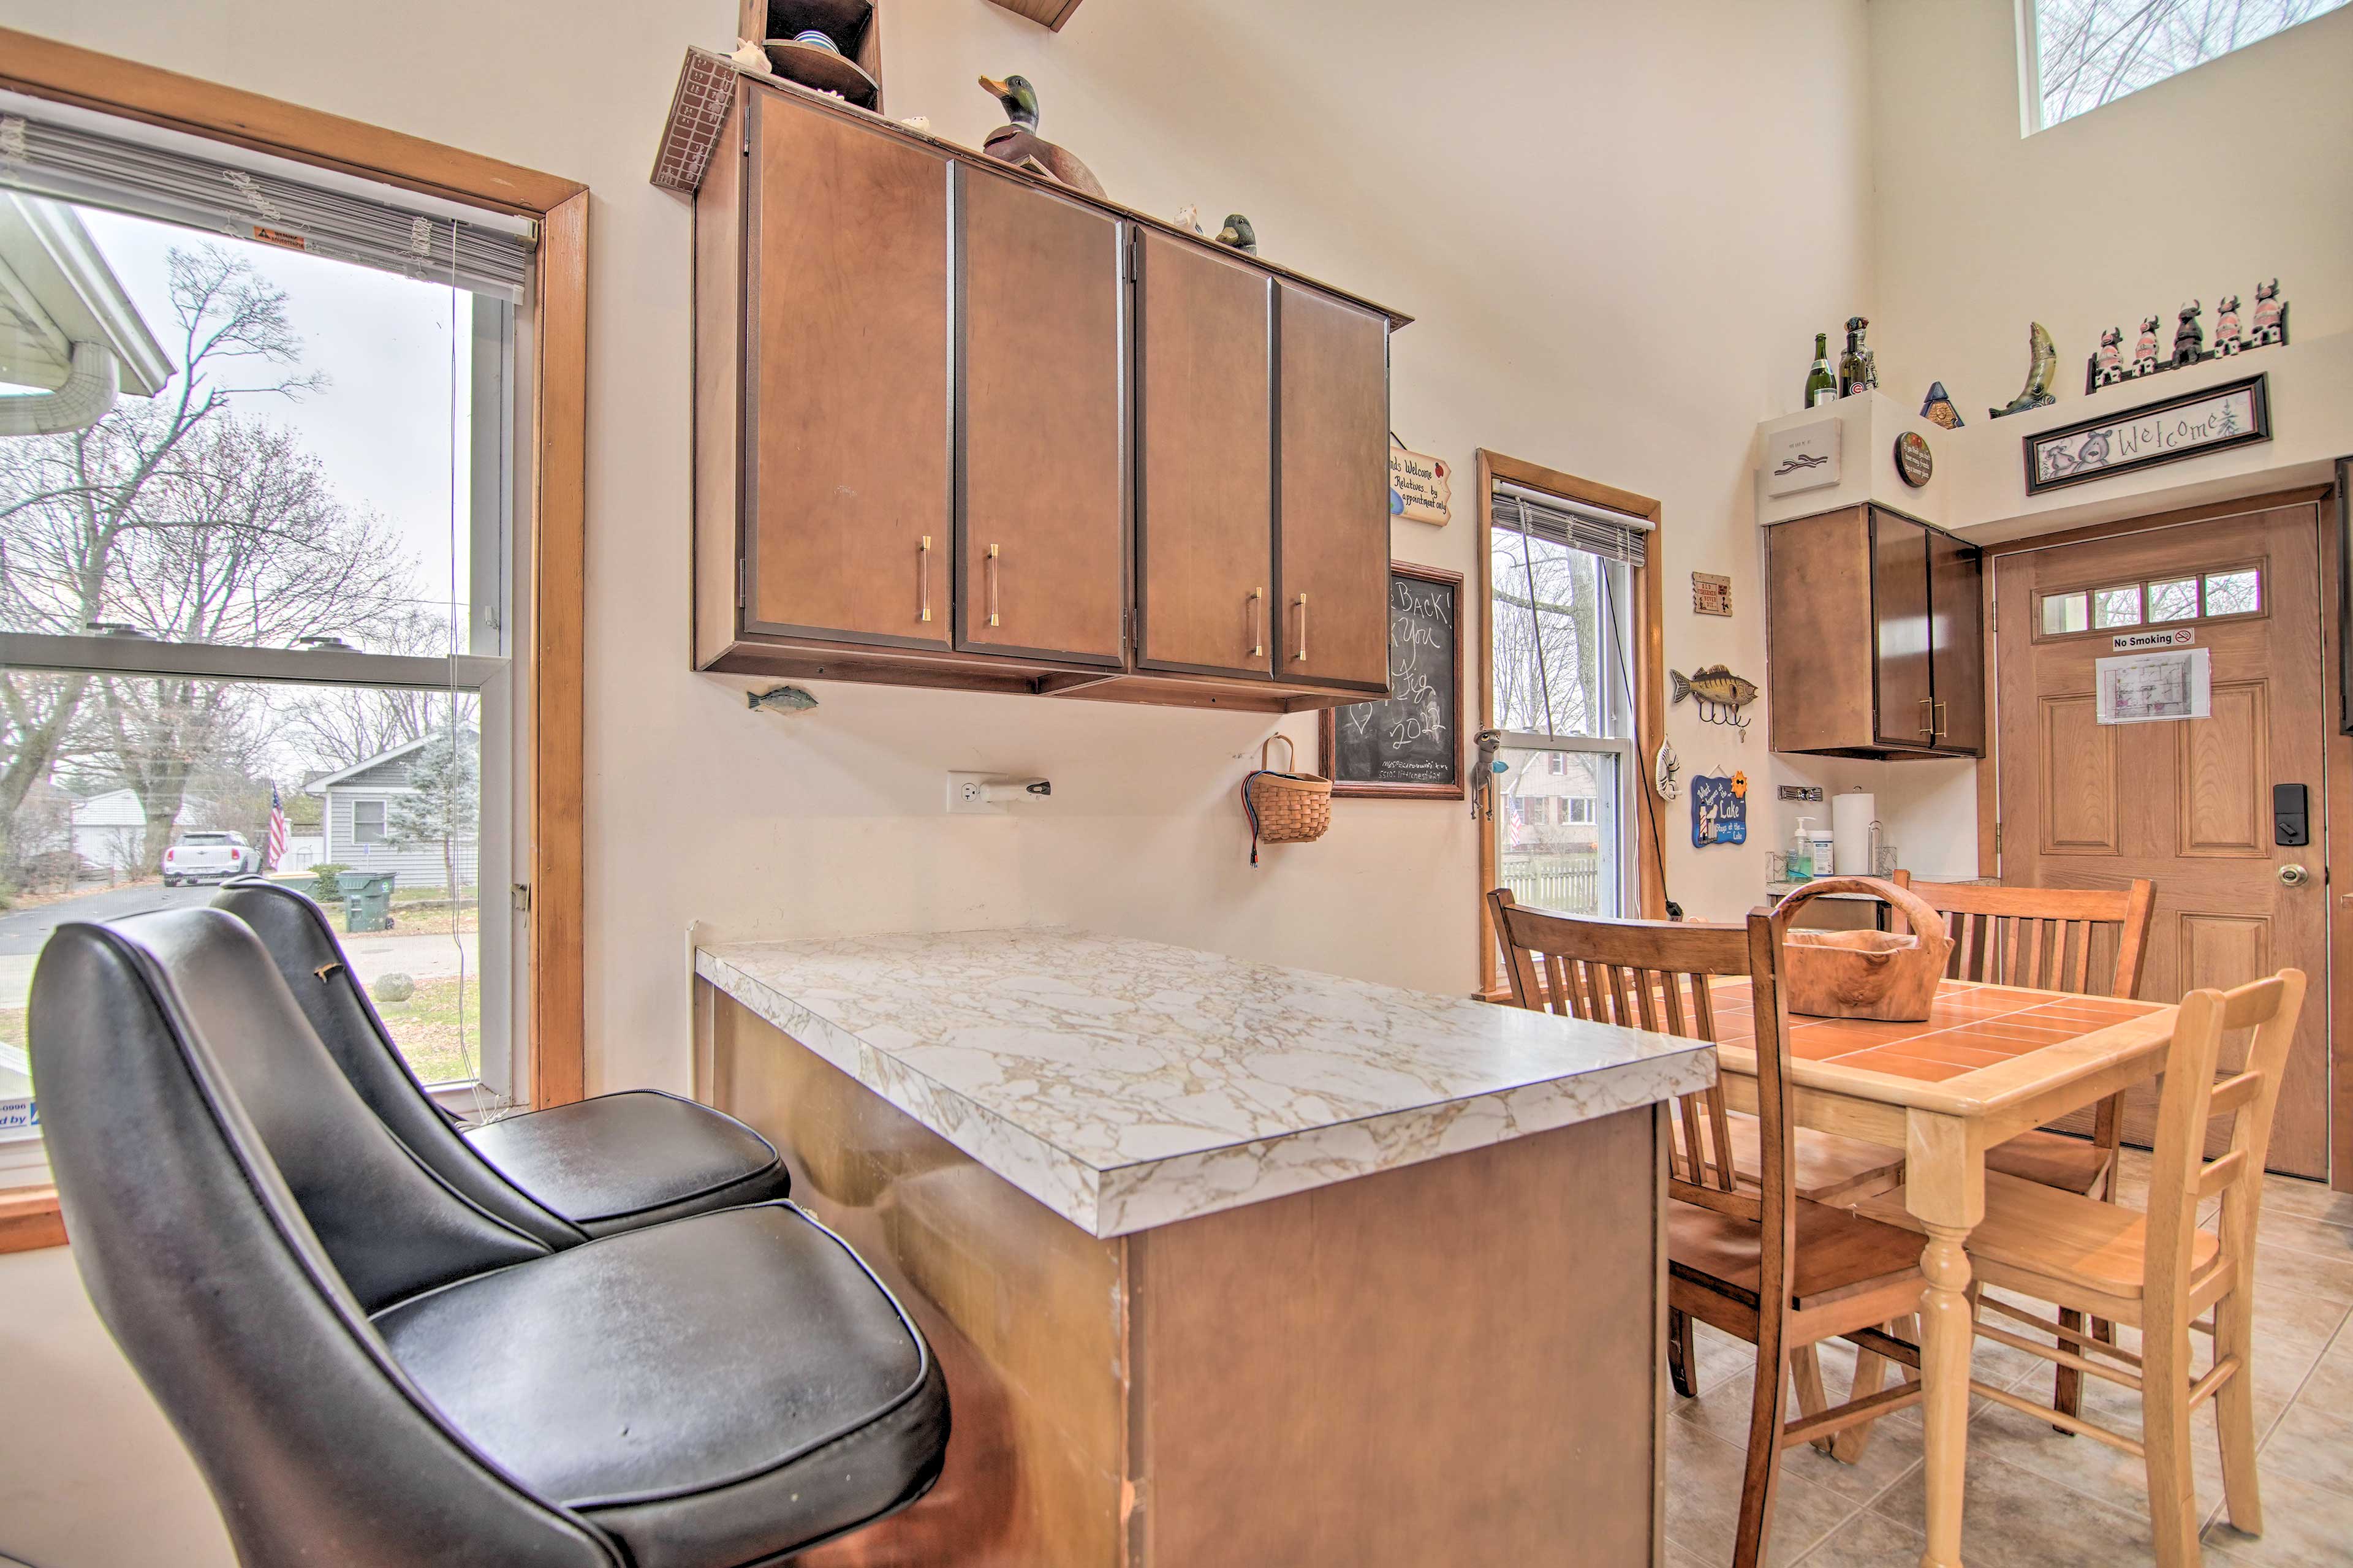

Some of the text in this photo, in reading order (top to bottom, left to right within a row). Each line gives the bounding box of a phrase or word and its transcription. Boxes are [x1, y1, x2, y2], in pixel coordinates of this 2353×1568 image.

[2118, 413, 2218, 456] Welcome
[1404, 459, 1433, 480] Welcome
[1431, 485, 1438, 499] by
[1403, 493, 1447, 515] appointment only
[2114, 634, 2172, 648] No Smoking
[1697, 782, 1711, 800] What
[1719, 800, 1740, 819] Lake
[1733, 830, 1743, 840] Lake
